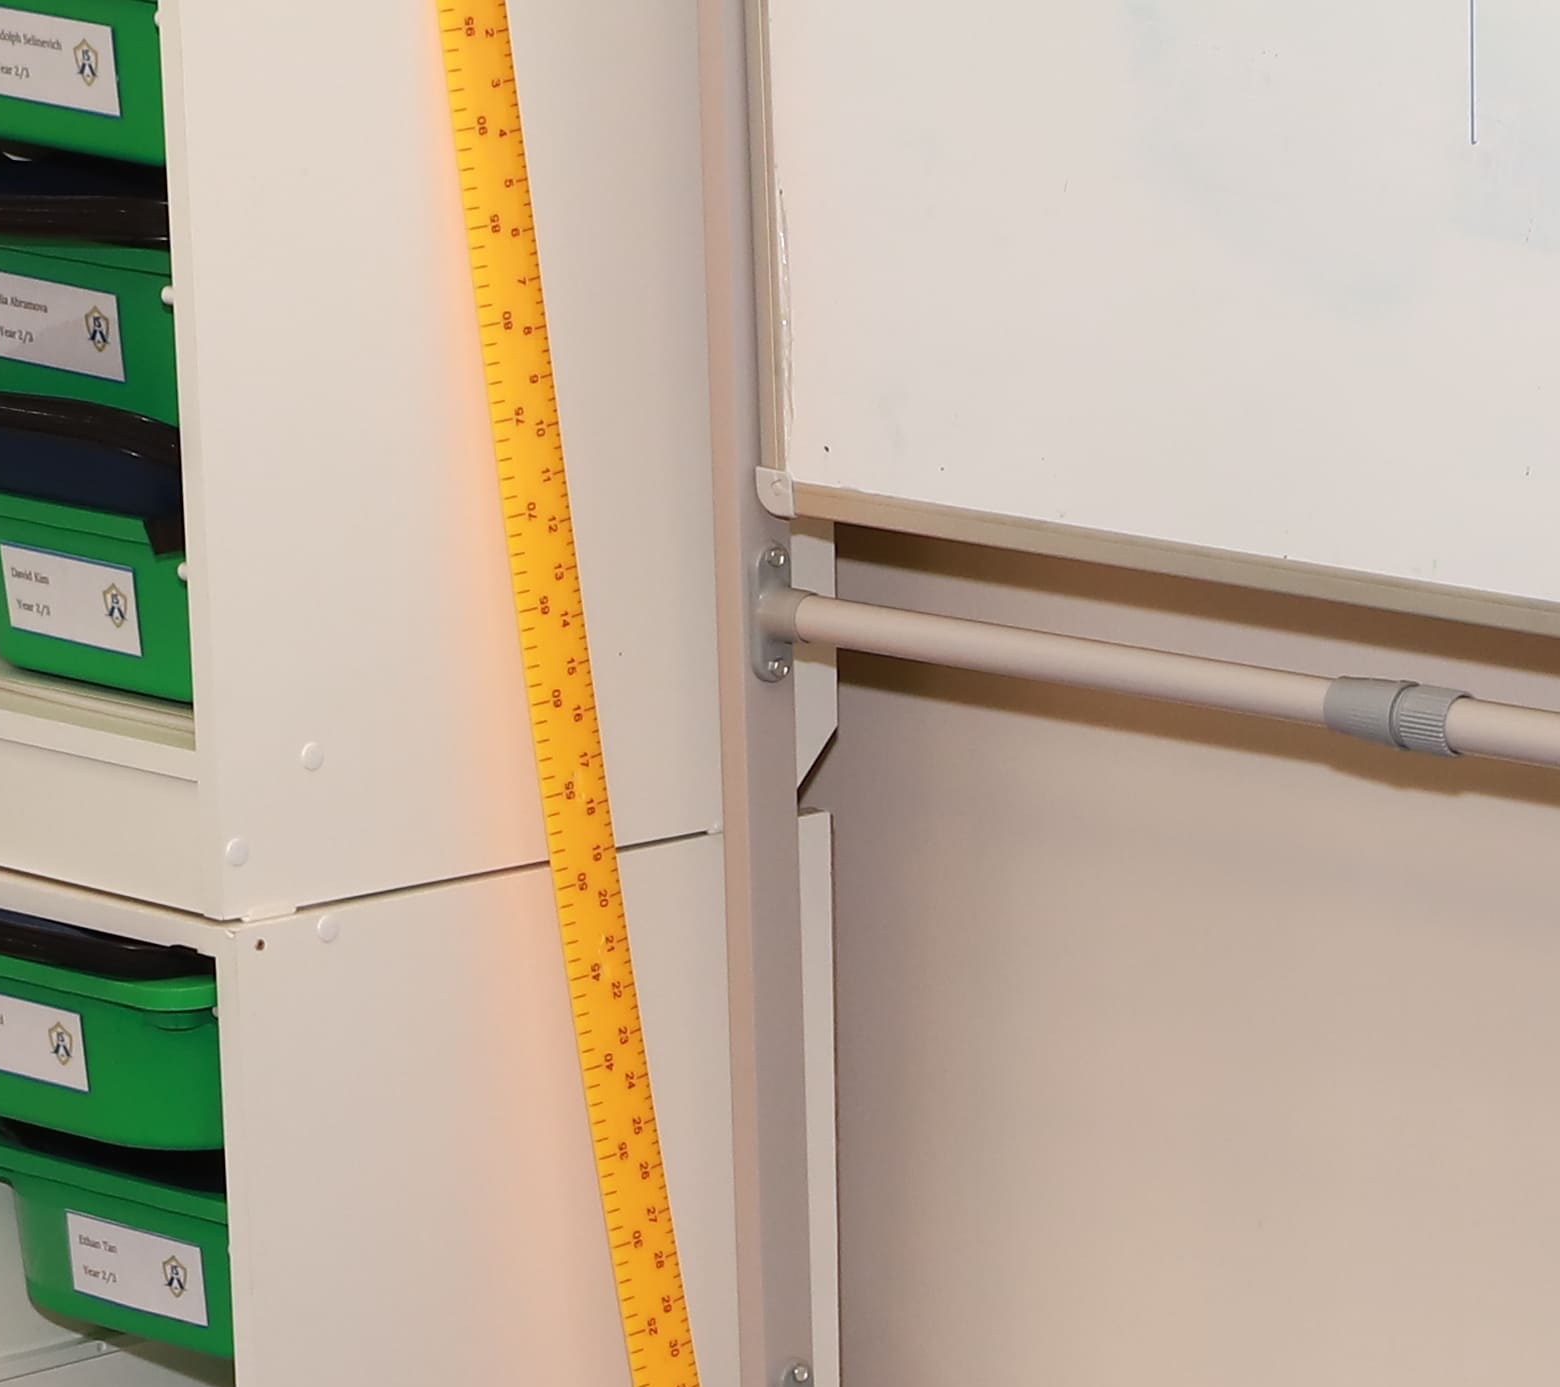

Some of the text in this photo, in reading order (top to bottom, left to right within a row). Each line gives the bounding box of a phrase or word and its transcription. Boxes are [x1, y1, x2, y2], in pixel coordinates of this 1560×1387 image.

[82, 1263, 100, 1278] Year
[465, 16, 475, 37] 95
[477, 116, 488, 136] 90
[490, 214, 501, 233] 85
[502, 311, 513, 330] 80
[514, 407, 525, 426] 75
[527, 502, 537, 520] 70
[539, 596, 550, 615] 65
[552, 689, 562, 708] 60
[564, 781, 576, 800] 55
[577, 872, 588, 891] 50
[590, 963, 601, 981] 45
[604, 1053, 614, 1071] 40
[618, 1142, 628, 1160] 35
[633, 1230, 643, 1248] 30
[647, 1318, 658, 1336] 25
[485, 28, 495, 37] 2
[491, 78, 501, 88] 3
[499, 129, 507, 138] 4
[504, 179, 514, 188] 5
[511, 227, 520, 238] 6
[517, 277, 526, 285] 7
[523, 326, 533, 336] 8
[529, 374, 539, 384] 9
[536, 419, 546, 437] 10
[541, 468, 552, 482] 11
[548, 516, 558, 533] 12
[554, 563, 564, 581] 13
[560, 611, 570, 628] 14
[567, 657, 577, 676] 15
[573, 705, 583, 722] 16
[579, 752, 589, 767] 17
[586, 797, 596, 816] 18
[592, 845, 602, 862] 19
[598, 889, 609, 908] 20
[605, 935, 616, 953] 21
[612, 981, 622, 1000] 22
[618, 1026, 629, 1045] 23
[625, 1072, 636, 1089] 24
[632, 1117, 643, 1135] 25
[640, 1161, 650, 1180] 26
[647, 1206, 658, 1223] 27
[654, 1251, 664, 1269] 28
[661, 1296, 672, 1313] 29
[669, 1339, 680, 1357] 30
